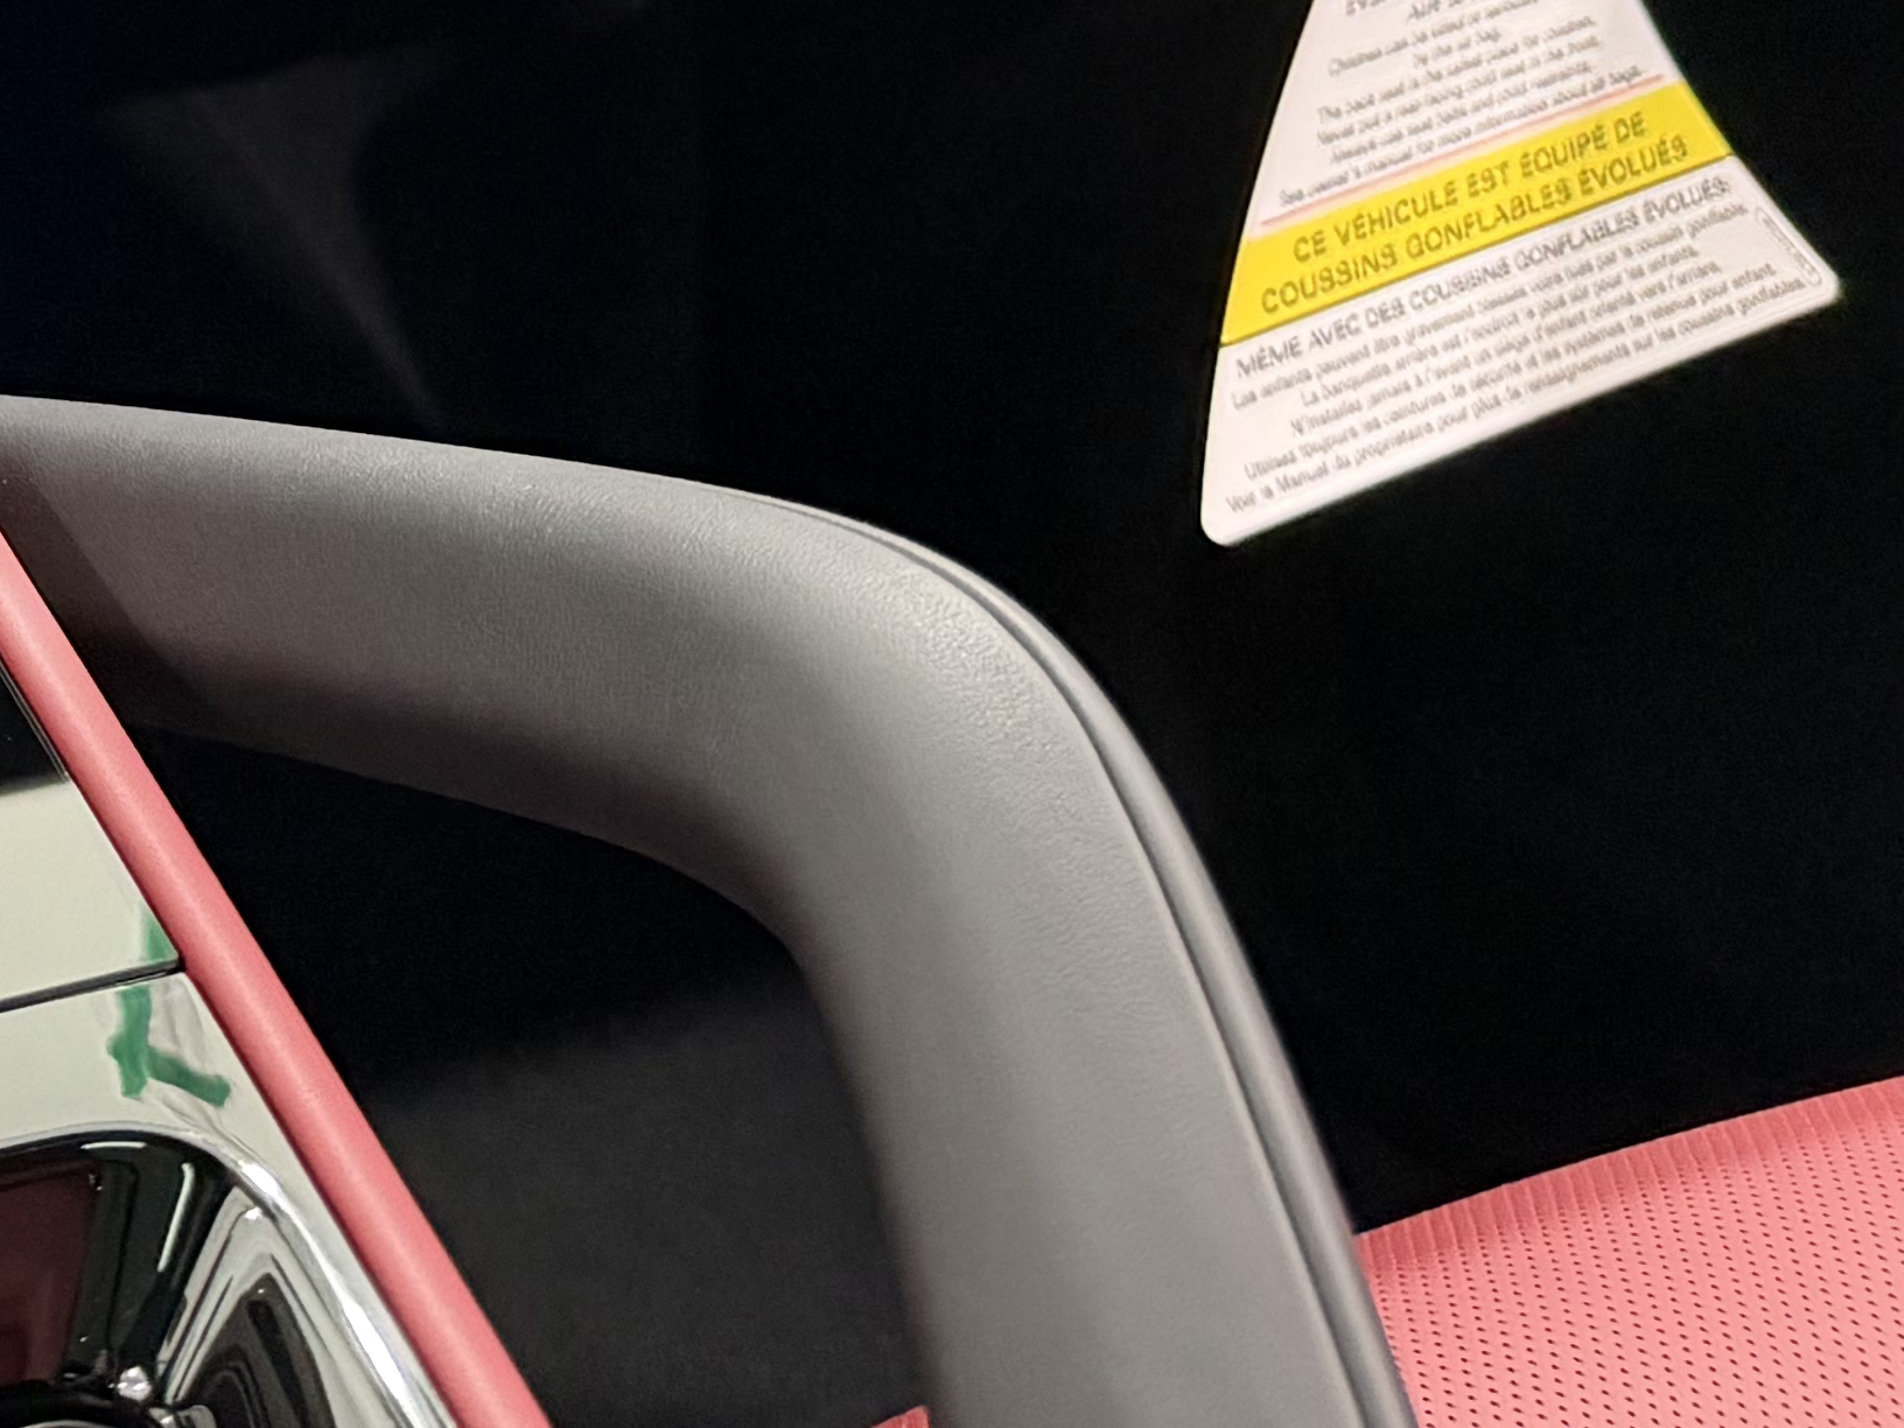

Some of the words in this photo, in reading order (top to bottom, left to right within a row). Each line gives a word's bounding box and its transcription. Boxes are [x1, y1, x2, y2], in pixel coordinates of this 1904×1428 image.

[1292, 229, 1327, 264] CE
[1332, 178, 1459, 247] VÉHICULE
[1466, 159, 1511, 198] EST
[1614, 109, 1647, 144] DE
[1259, 243, 1400, 315] COUSSINS
